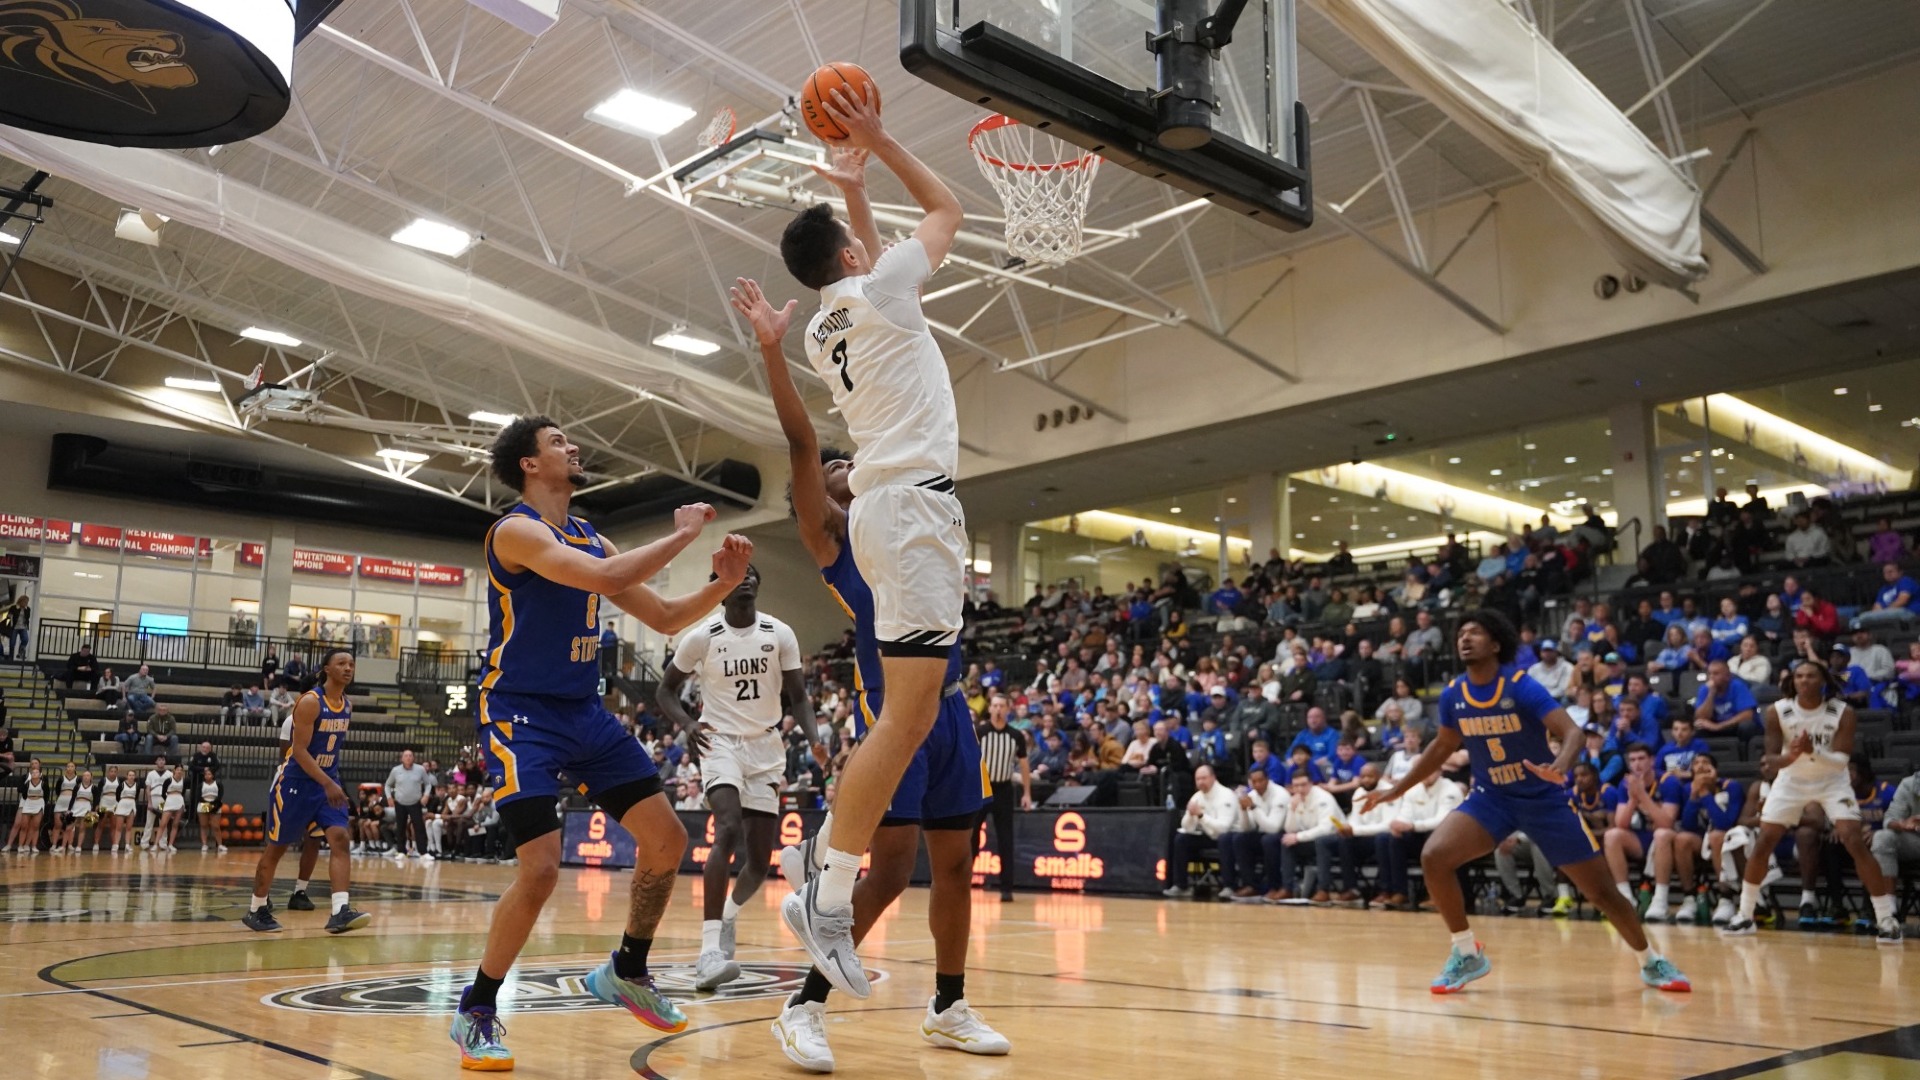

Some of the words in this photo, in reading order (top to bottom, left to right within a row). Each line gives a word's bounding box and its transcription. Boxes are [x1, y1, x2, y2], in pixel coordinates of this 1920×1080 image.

[831, 337, 854, 393] 7
[0, 524, 60, 540] CHAMPON
[150, 542, 195, 556] CHAMPION
[295, 550, 346, 564] INVITATIONAL
[373, 565, 412, 578] NATIONAL
[570, 635, 599, 663] STAT
[723, 657, 768, 677] LIONS
[735, 679, 761, 702] 21
[1458, 712, 1522, 737] MOREHEAD
[1486, 737, 1506, 762] 5
[1487, 762, 1526, 785] STATE
[577, 840, 613, 858] smalls
[1034, 853, 1103, 878] smalls
